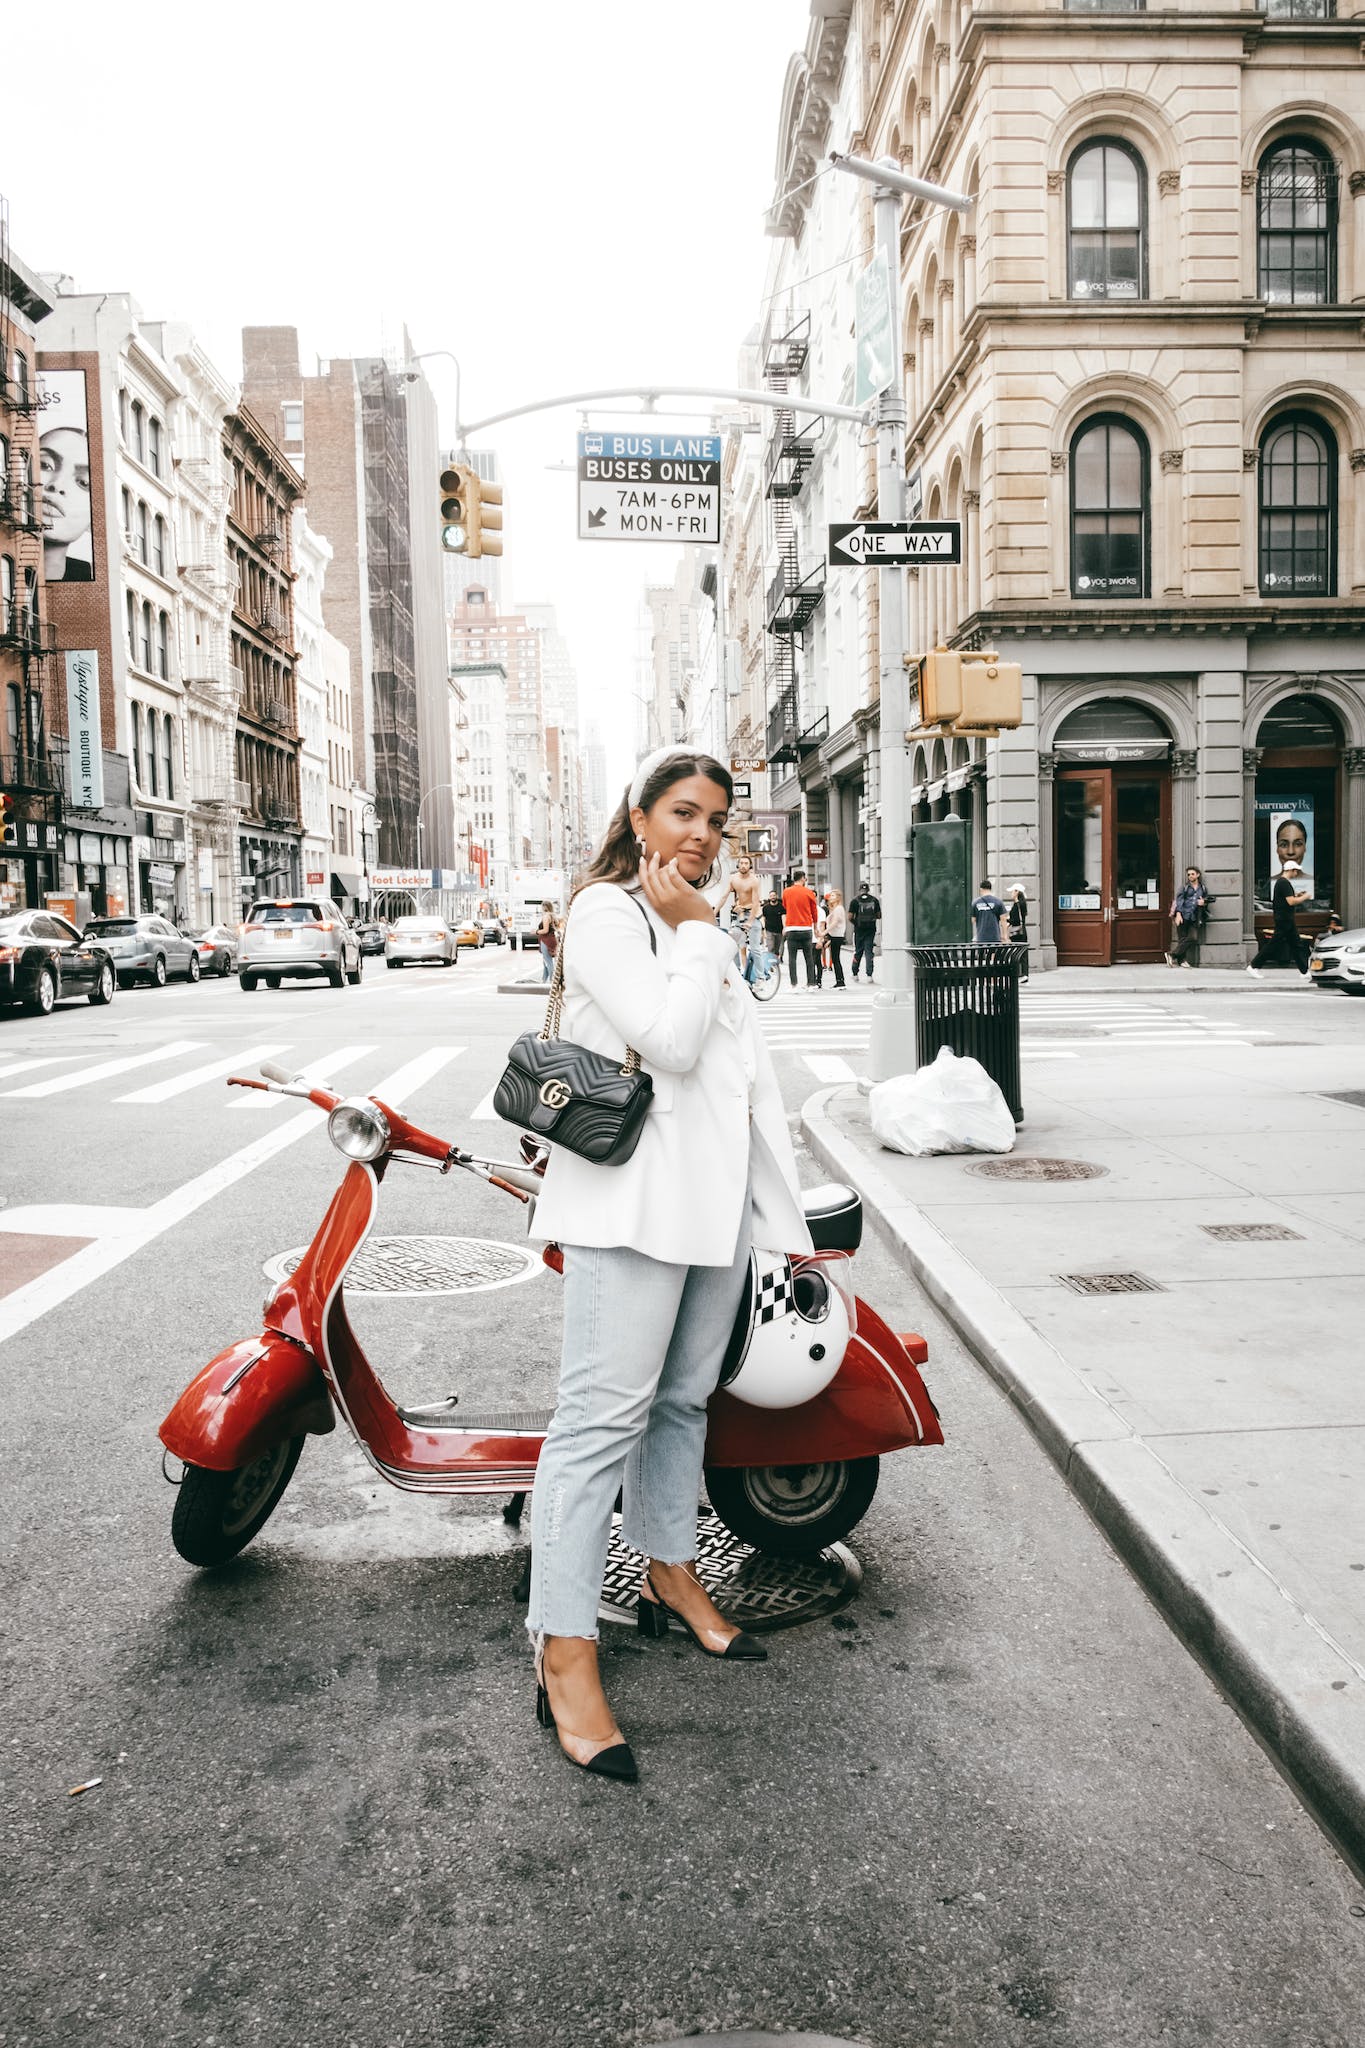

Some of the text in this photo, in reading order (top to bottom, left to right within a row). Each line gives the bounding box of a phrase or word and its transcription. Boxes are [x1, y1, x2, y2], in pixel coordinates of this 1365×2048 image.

[613, 437, 713, 457] BUS LANE
[586, 460, 712, 482] BUSES ONLY
[617, 490, 711, 510] 7AM-6PM
[621, 514, 706, 533] MON-FRI
[849, 535, 943, 553] ONE WAY
[73, 653, 93, 806] Mystique BOUTIQUE NYC
[735, 760, 760, 768] GRAND
[1254, 800, 1297, 812] harmacy
[372, 875, 430, 884] Foot Locker
